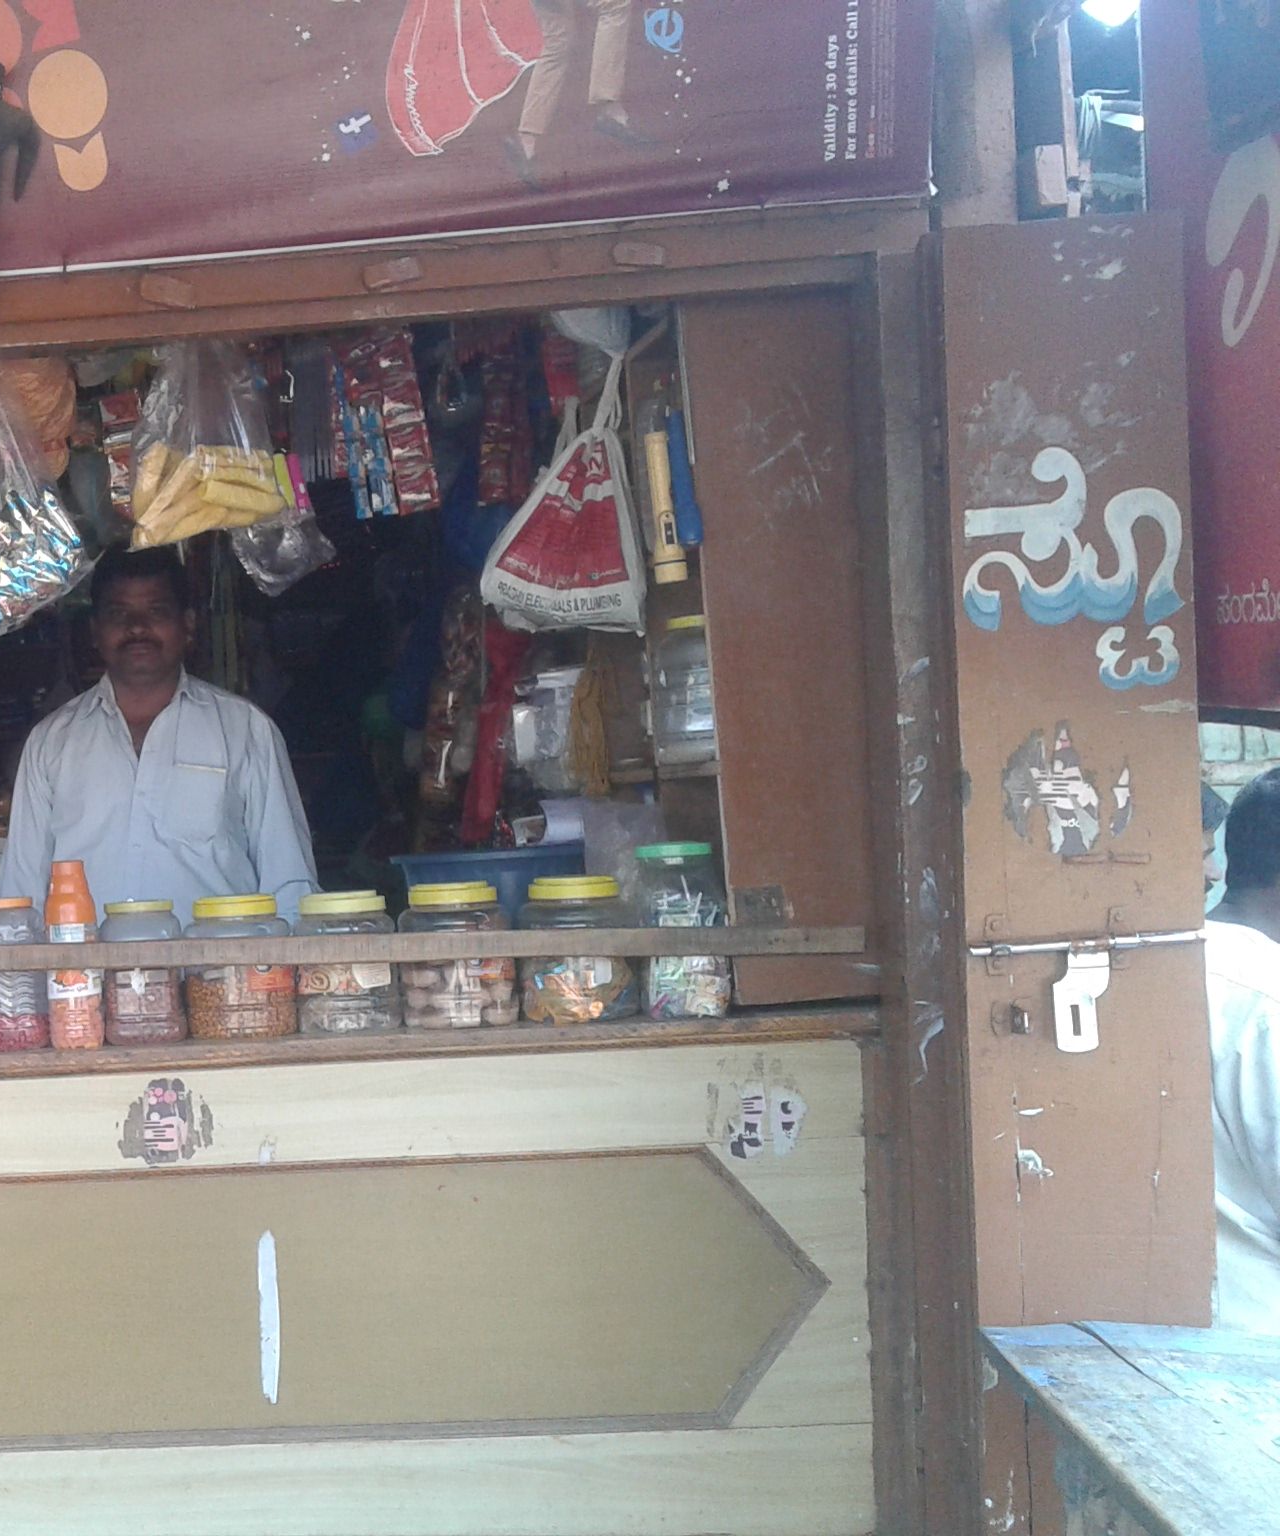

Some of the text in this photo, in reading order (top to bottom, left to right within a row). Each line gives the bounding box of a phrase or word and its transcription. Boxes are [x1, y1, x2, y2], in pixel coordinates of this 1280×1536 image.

[845, 9, 859, 40] Call
[824, 34, 840, 69] days
[825, 72, 837, 91] 30
[823, 104, 839, 162] Validity
[846, 98, 858, 135] more
[845, 137, 858, 162] For
